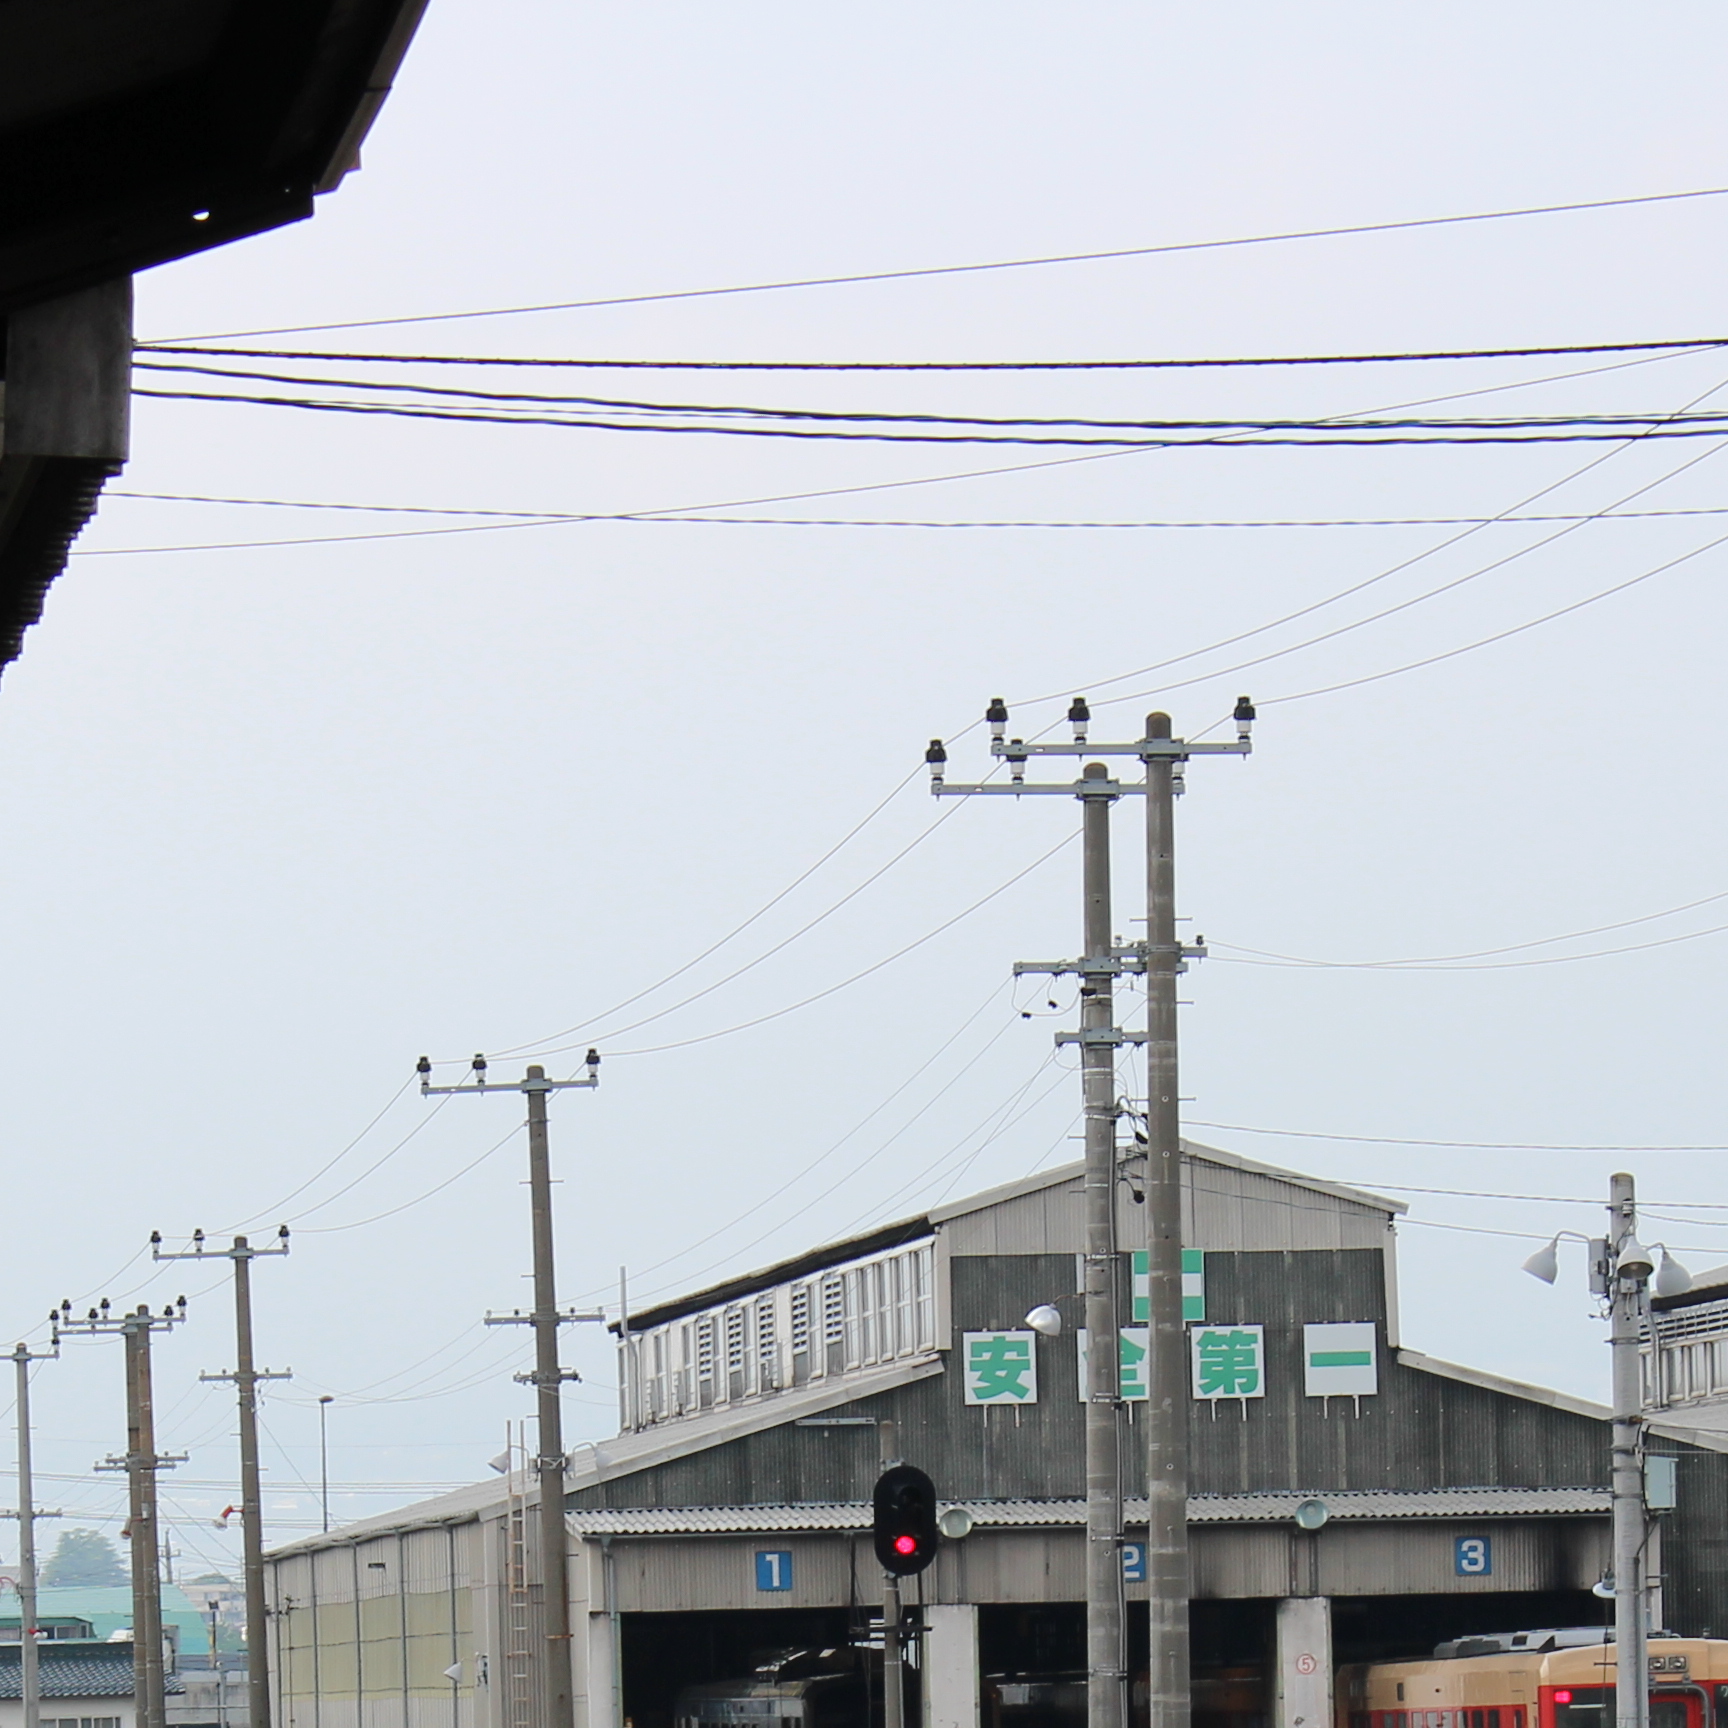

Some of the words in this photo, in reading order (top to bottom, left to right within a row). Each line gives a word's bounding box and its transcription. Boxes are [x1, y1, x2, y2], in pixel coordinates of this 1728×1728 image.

[765, 1554, 780, 1587] 1
[1123, 1545, 1141, 1579] 2
[1460, 1541, 1486, 1573] 3
